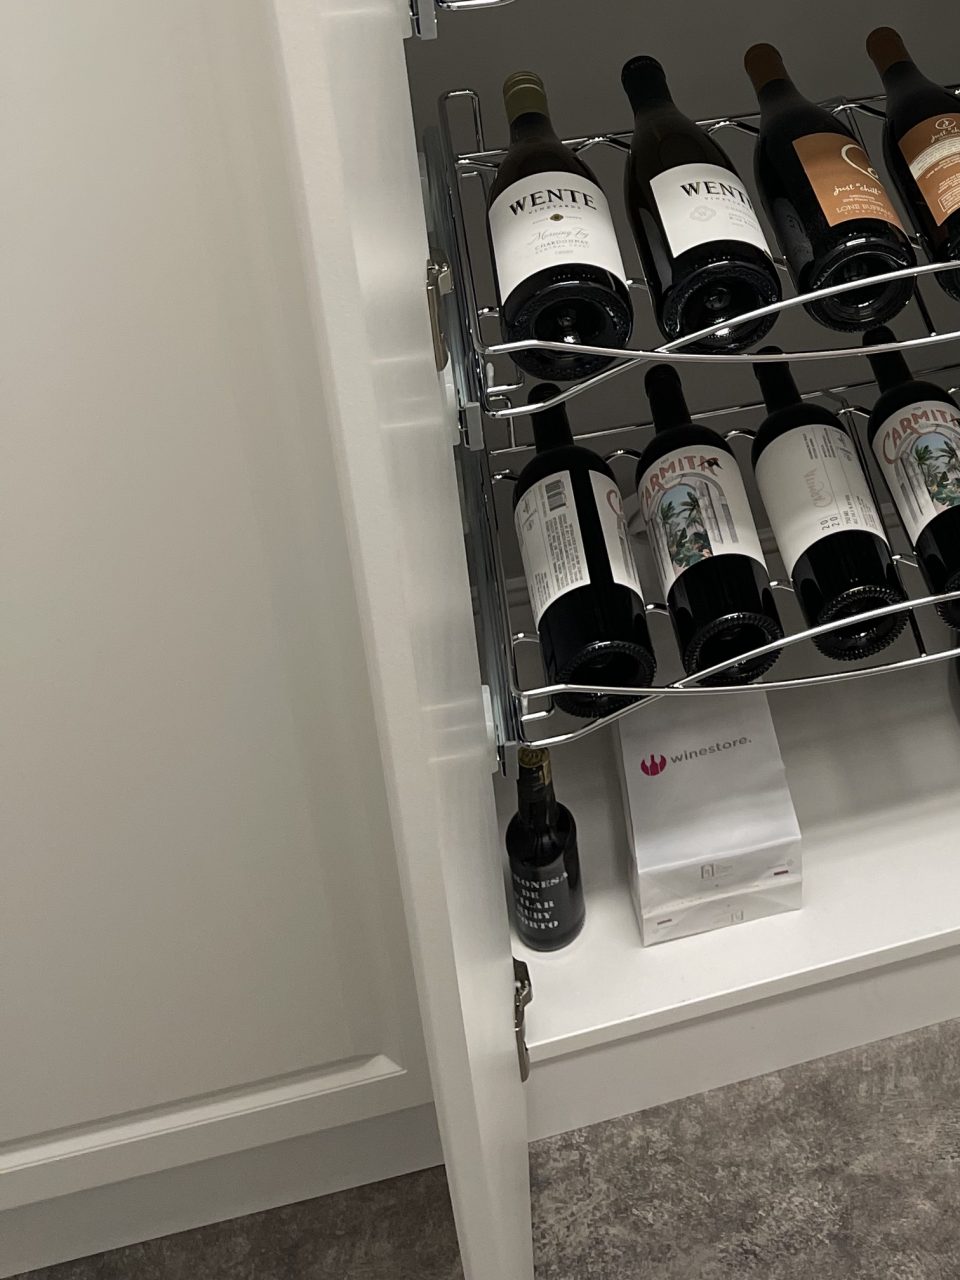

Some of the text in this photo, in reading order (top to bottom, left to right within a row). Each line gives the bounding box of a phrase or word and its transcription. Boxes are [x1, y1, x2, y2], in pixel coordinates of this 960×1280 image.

[833, 184, 855, 196] just
[508, 188, 598, 216] WENTE
[835, 203, 860, 213] LONE
[670, 736, 752, 764] winestore.
[521, 888, 540, 900] DE
